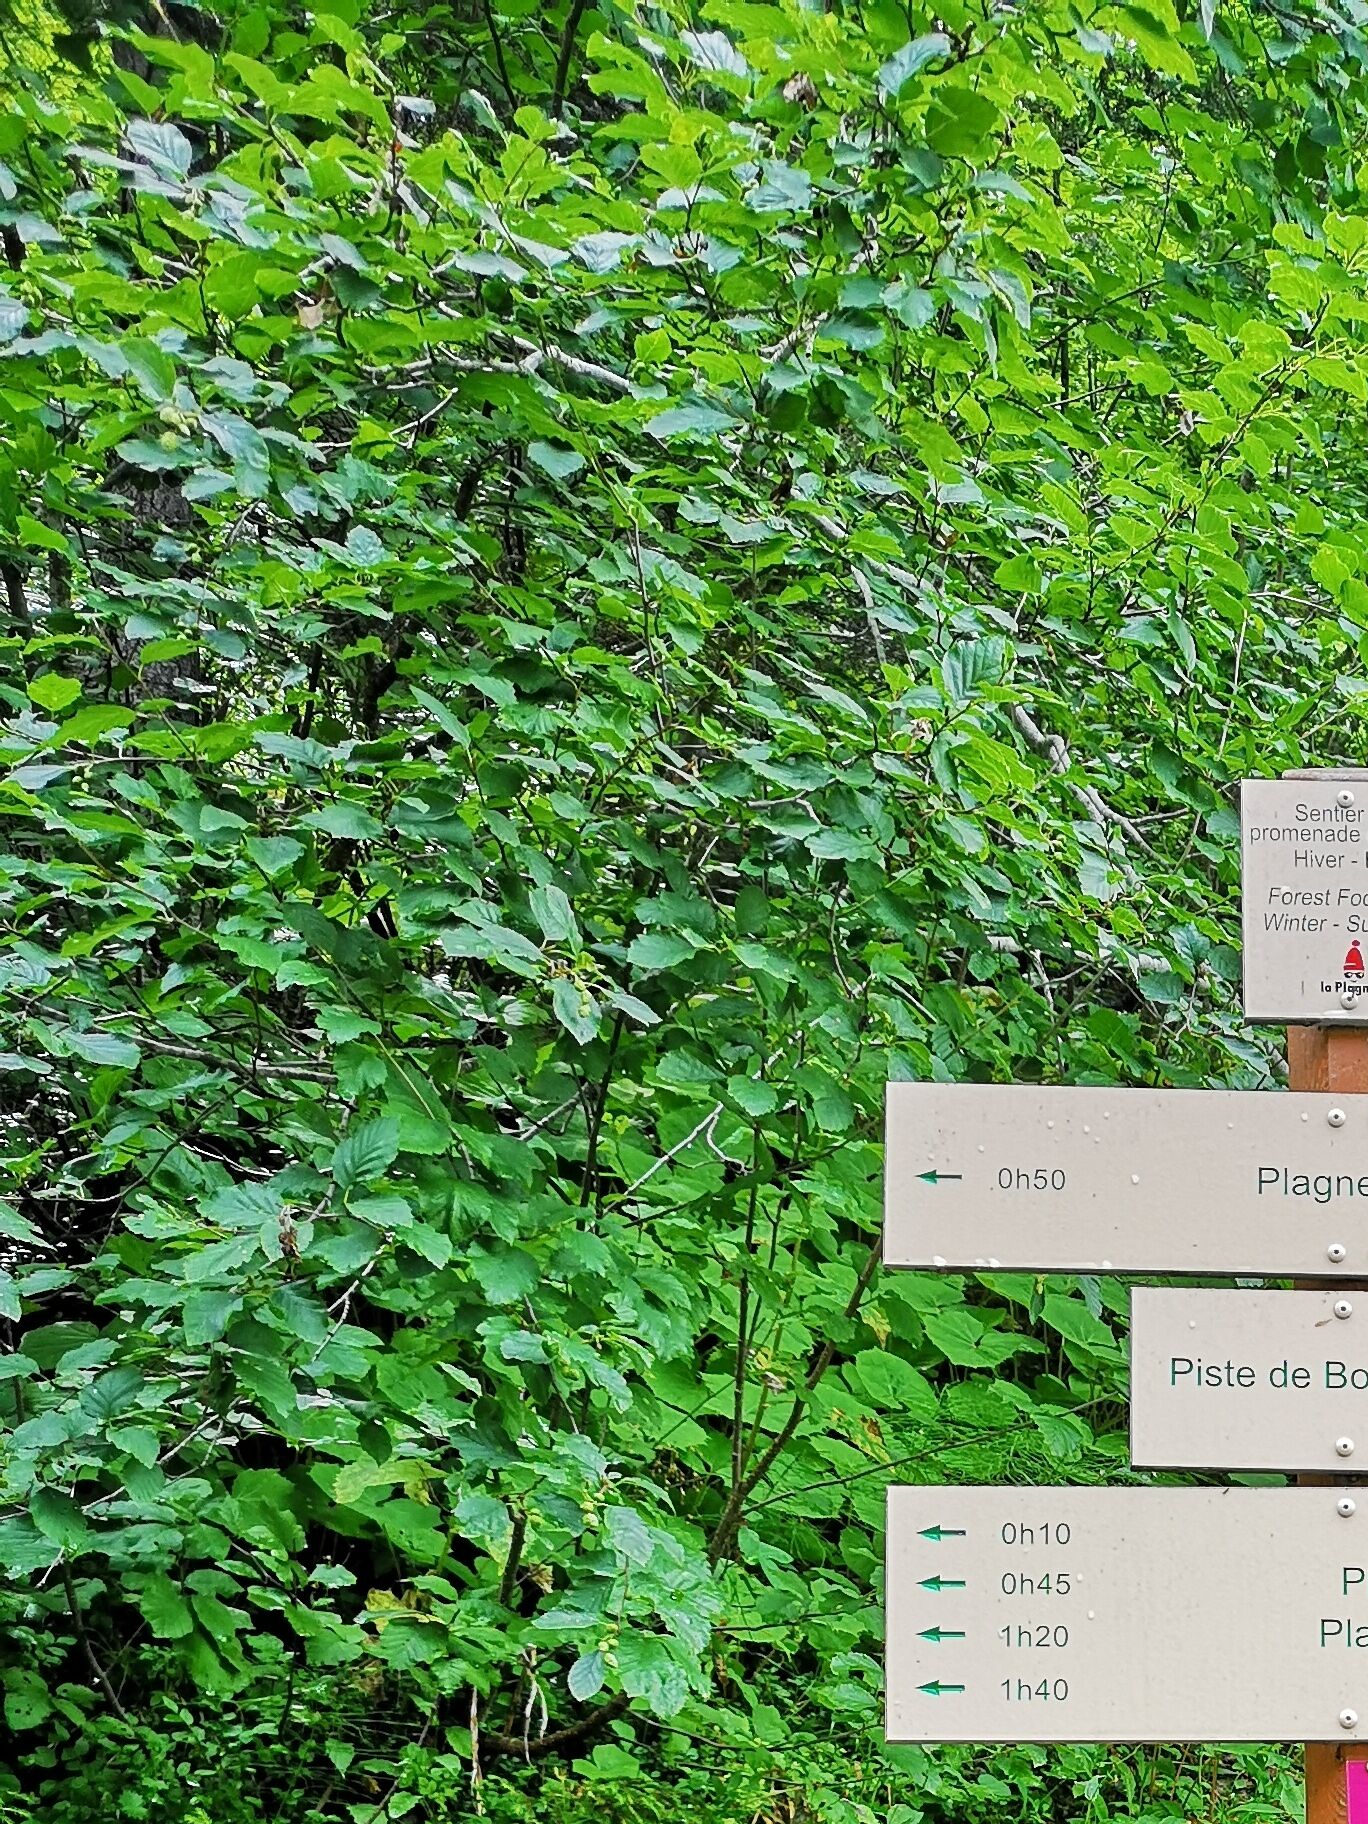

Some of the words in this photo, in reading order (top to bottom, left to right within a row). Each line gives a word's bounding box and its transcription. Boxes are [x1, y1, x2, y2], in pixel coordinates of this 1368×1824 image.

[1295, 804, 1364, 823] Sentier
[1250, 824, 1361, 845] promenade
[1294, 849, 1345, 869] Hiver
[1268, 887, 1331, 906] Forest
[1264, 913, 1328, 932] Winter
[1320, 981, 1332, 993] la
[998, 1167, 1066, 1191] 0h50
[1171, 1357, 1256, 1388] Piste
[1269, 1359, 1311, 1389] de
[1001, 1522, 1071, 1545] 0h10
[1001, 1572, 1071, 1595] 0h45
[1001, 1625, 1069, 1648] 1h20
[1001, 1678, 1069, 1701] 1h40
